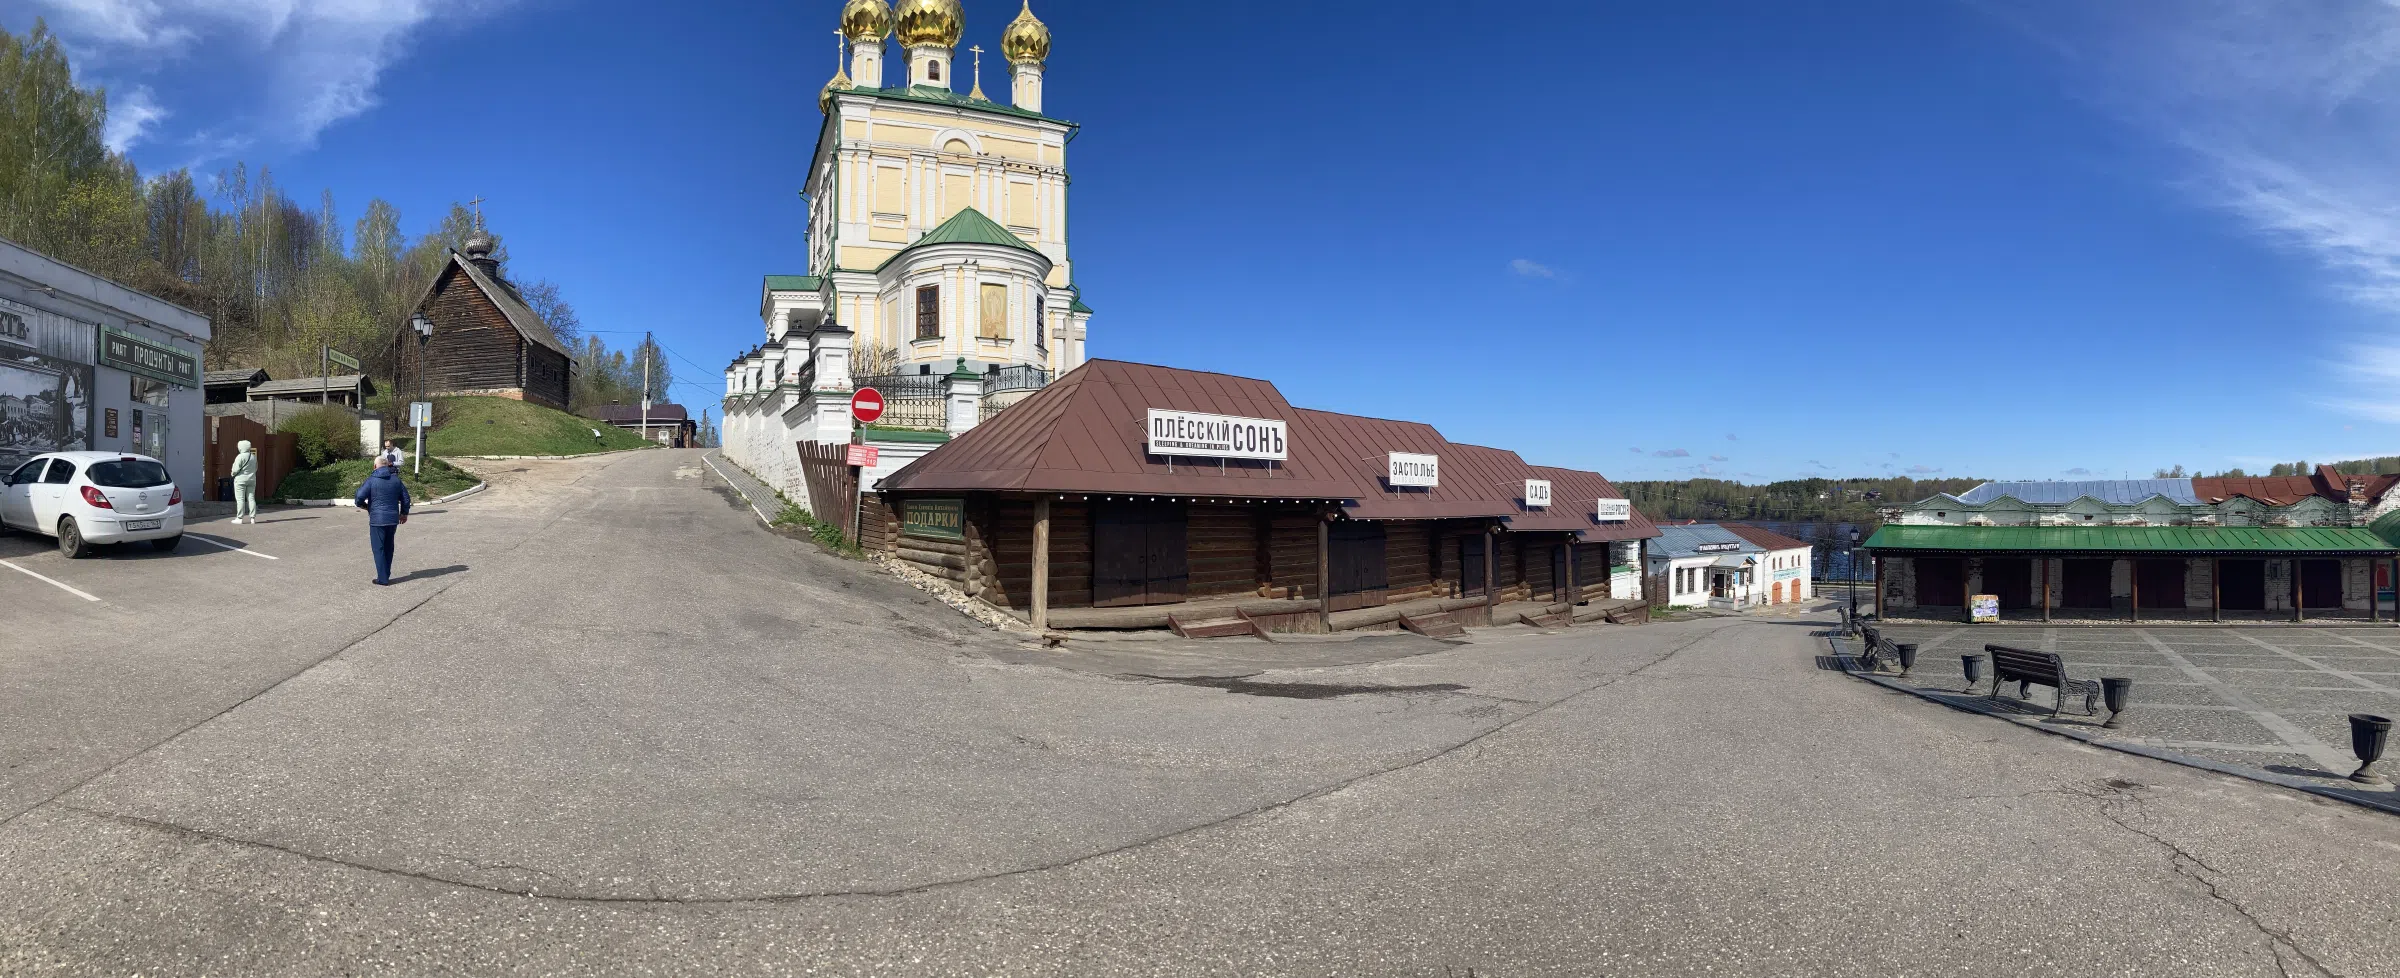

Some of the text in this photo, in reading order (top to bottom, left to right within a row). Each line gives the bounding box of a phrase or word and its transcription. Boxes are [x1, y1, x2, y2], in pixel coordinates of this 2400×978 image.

[134, 346, 174, 373] ПРОДУКТЫ
[1154, 416, 1283, 453] ПЛЁССКІЙ СОНЪ
[1155, 440, 1178, 448] SLEEPING
[1392, 461, 1435, 478] ЗАСТОЛЬЕ
[1529, 484, 1549, 500] САДЪ
[906, 511, 959, 528] ПОДАРКИ
